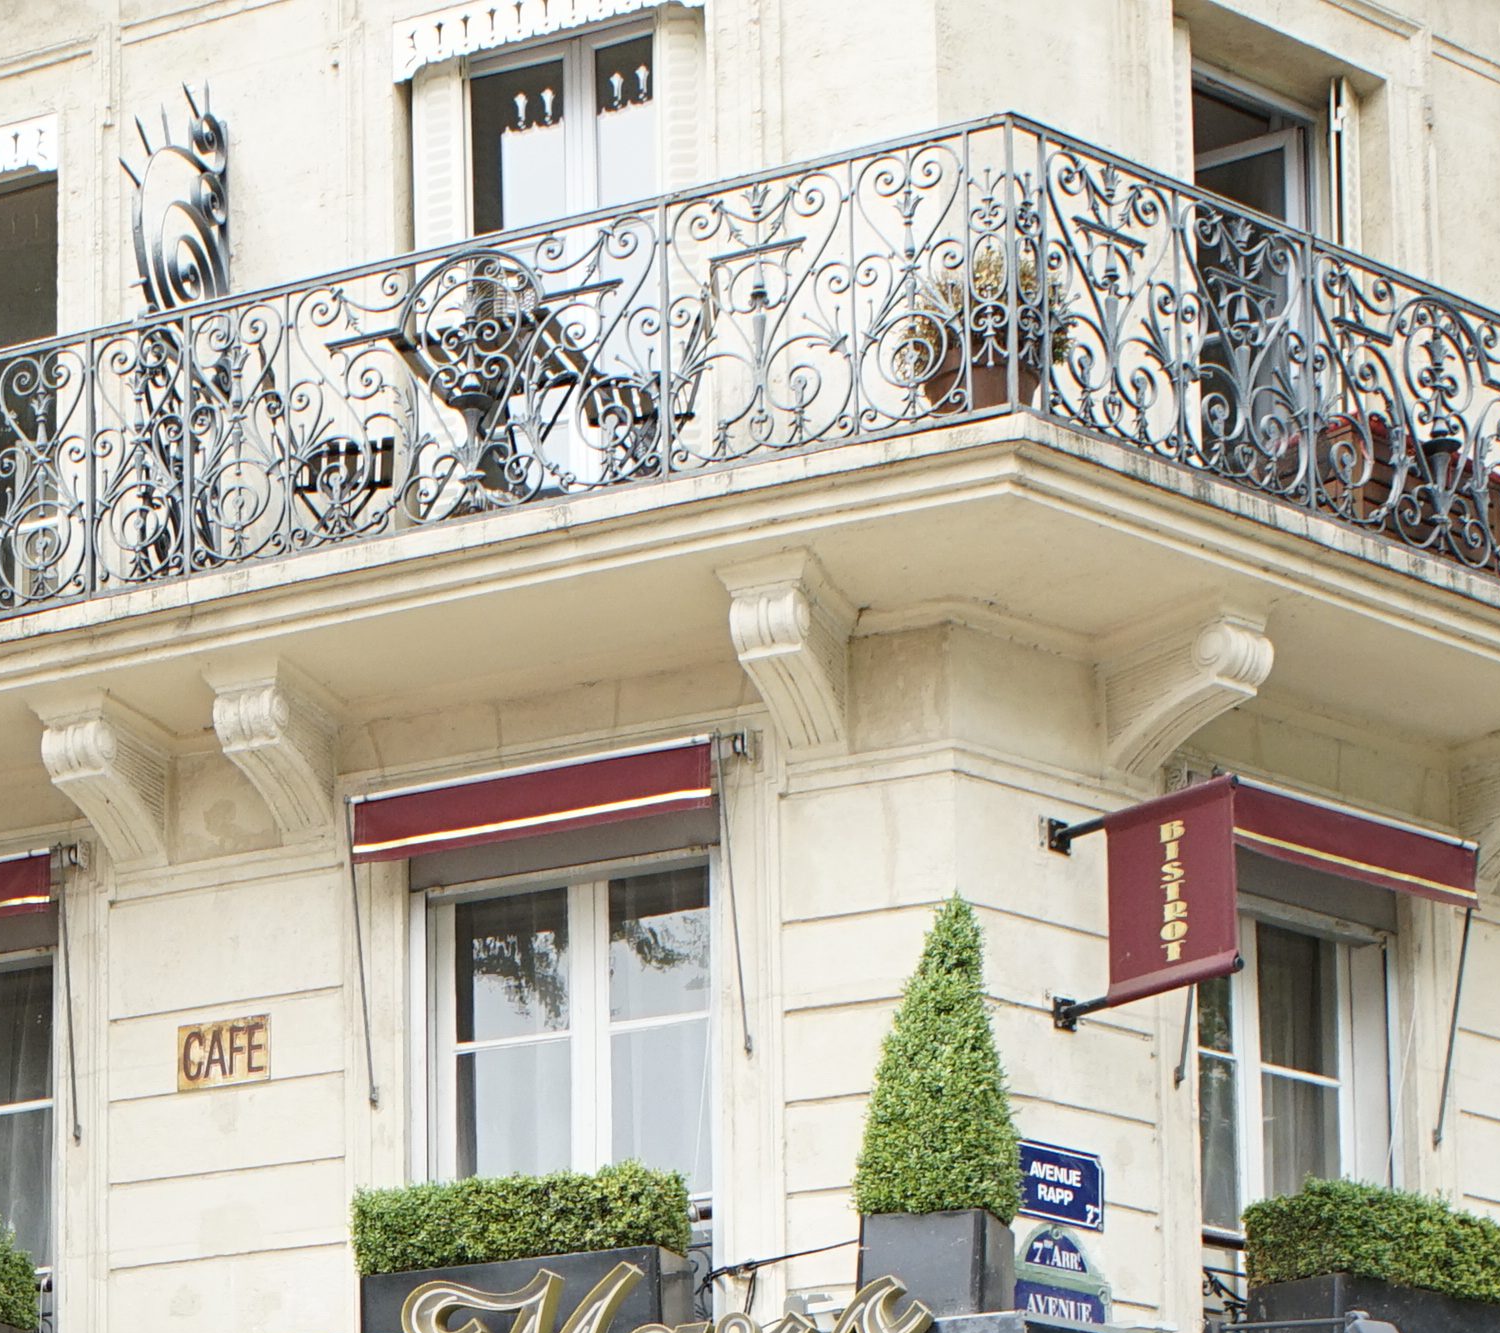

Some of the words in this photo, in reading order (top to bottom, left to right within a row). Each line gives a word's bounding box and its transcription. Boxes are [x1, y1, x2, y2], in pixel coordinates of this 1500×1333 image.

[1159, 819, 1189, 962] BISTROT
[1030, 1161, 1082, 1188] AVENUE
[1037, 1183, 1074, 1206] RAPP
[1027, 1293, 1093, 1324] AVENUE
